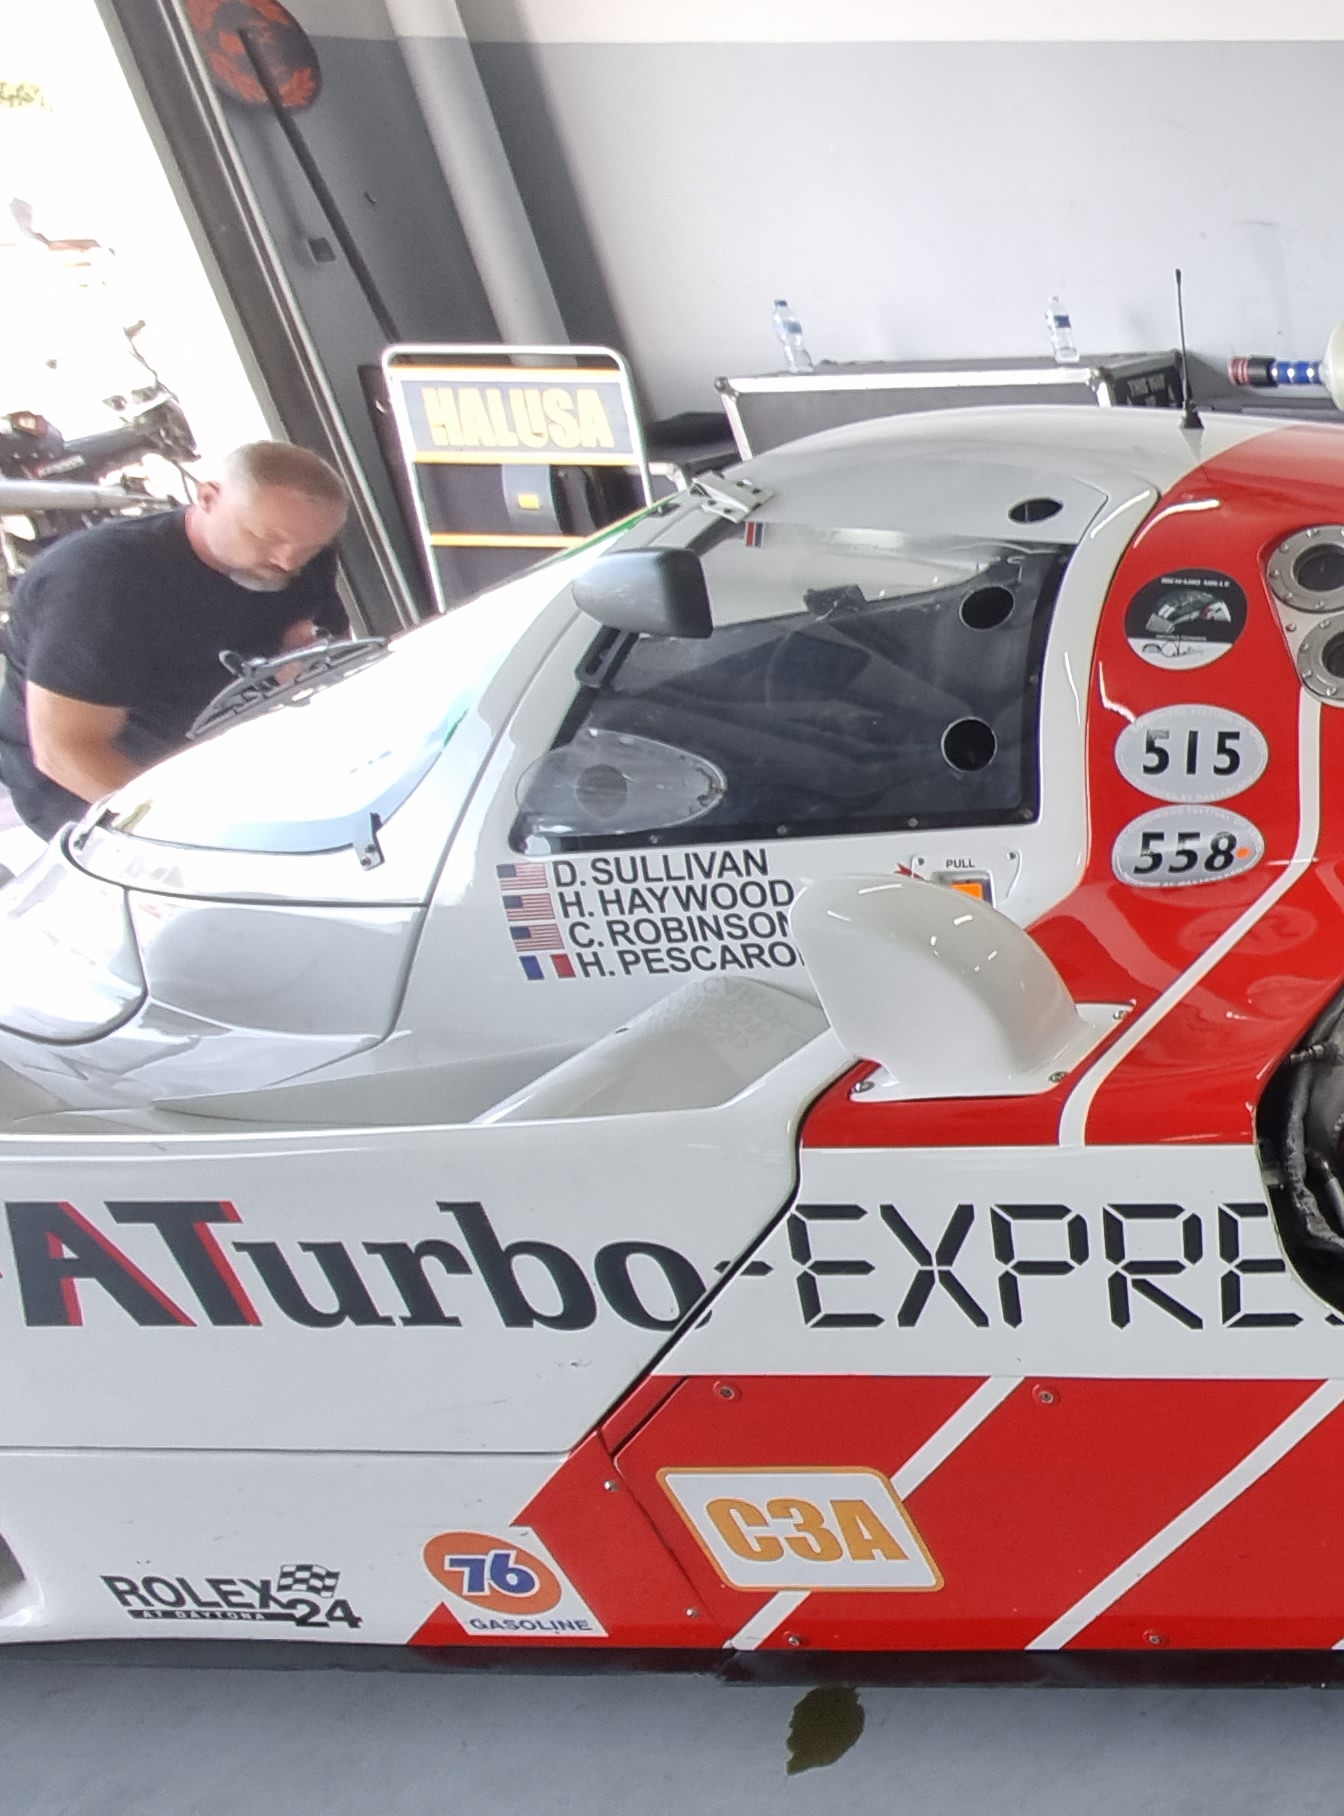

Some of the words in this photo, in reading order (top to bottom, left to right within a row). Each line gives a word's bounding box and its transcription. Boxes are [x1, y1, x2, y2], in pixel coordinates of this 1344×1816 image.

[421, 386, 616, 449] HALUSA
[1142, 730, 1242, 777] 515
[552, 858, 587, 888] D.
[590, 848, 769, 886] SULLIVAN
[945, 858, 976, 869] PULL
[1133, 831, 1238, 875] 558
[560, 889, 595, 919] H.
[598, 879, 796, 916] HAYWOOD
[568, 920, 605, 949] C.
[575, 950, 616, 978] H.
[616, 940, 805, 977] PESCARO
[705, 1498, 911, 1562] C3A
[446, 1550, 539, 1597] 76
[99, 1574, 297, 1611] ROLEX
[284, 1598, 364, 1629] 24
[142, 1610, 160, 1620] AT
[175, 1611, 267, 1622] DAYTONA
[469, 1617, 593, 1632] GASOLINE
